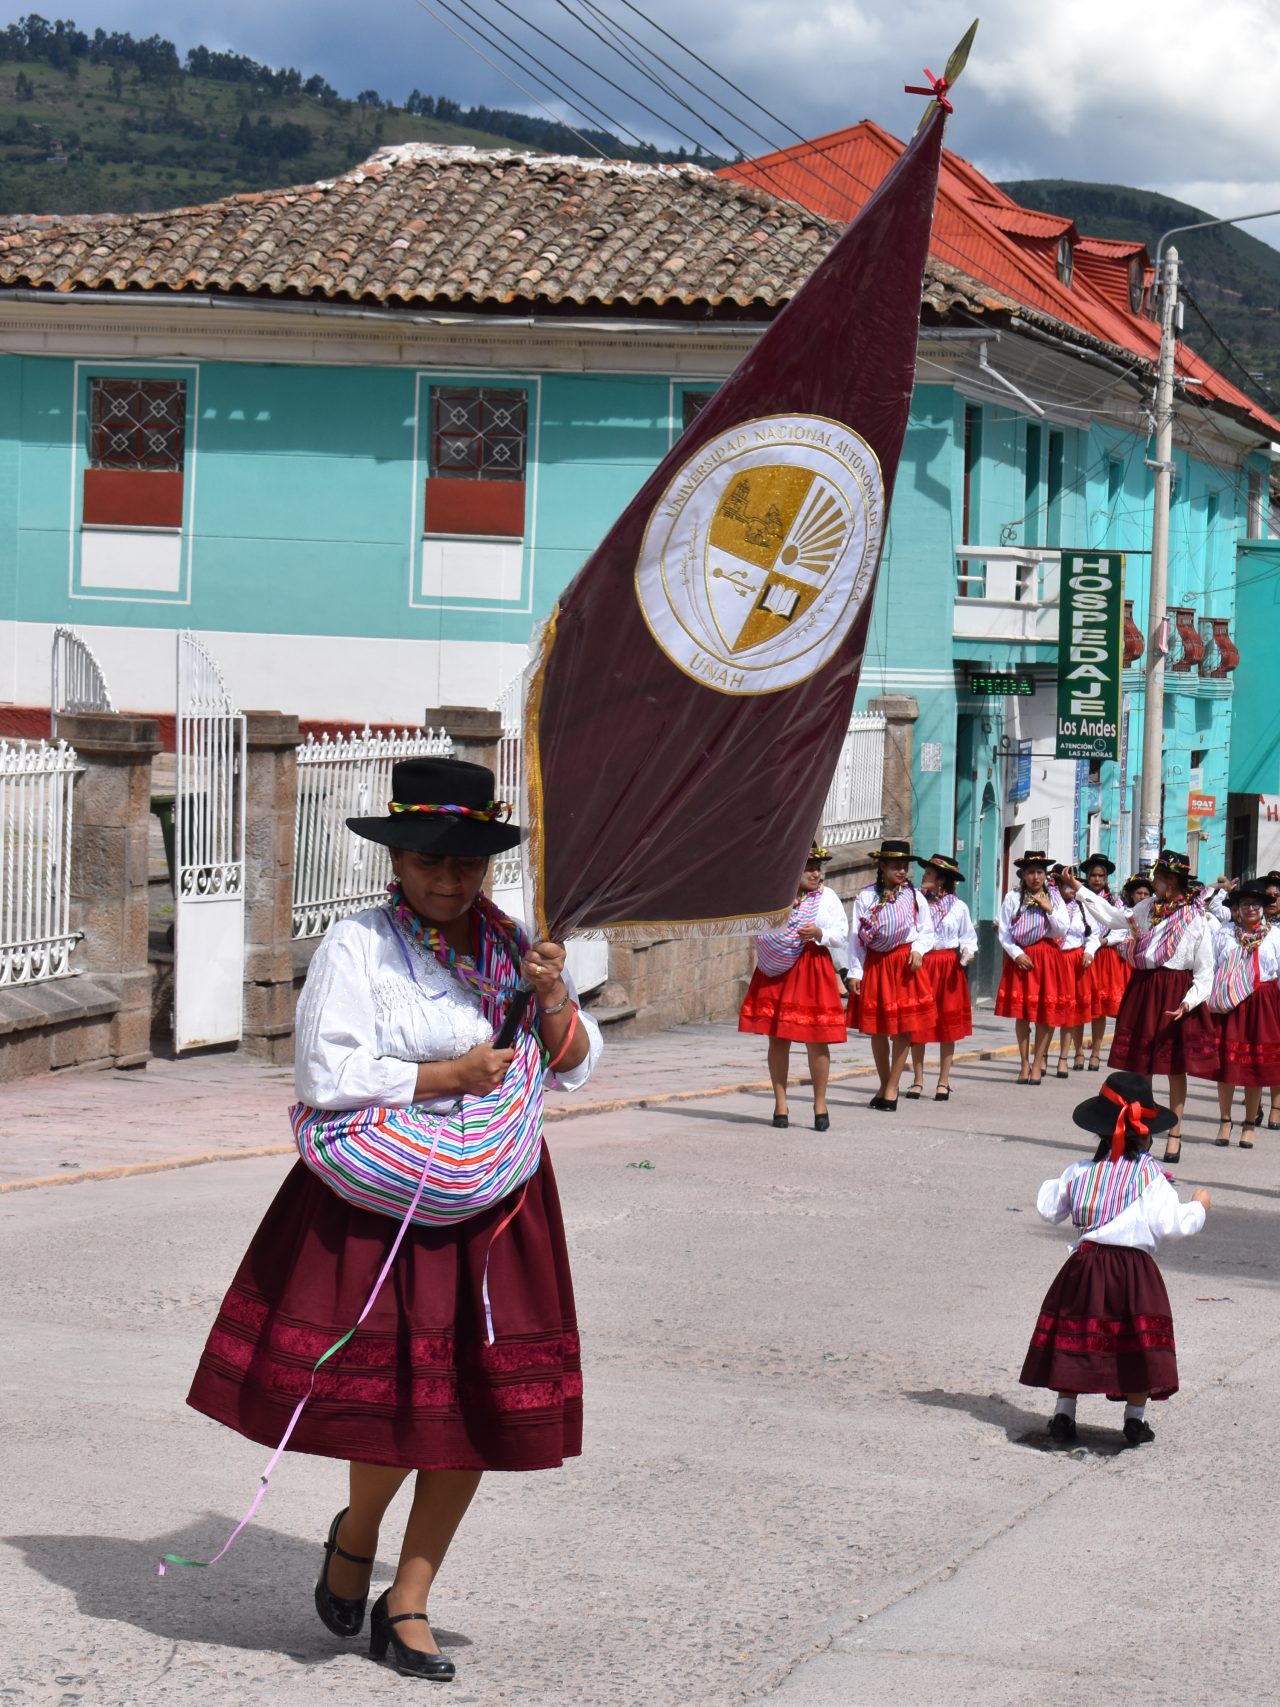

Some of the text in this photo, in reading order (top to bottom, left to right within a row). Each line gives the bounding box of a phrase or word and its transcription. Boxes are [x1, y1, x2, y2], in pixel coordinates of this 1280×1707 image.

[754, 425, 832, 447] NACIONAL
[665, 434, 748, 519] UNIVERSIDAD
[868, 510, 878, 530] DE
[850, 537, 876, 601] HUANTA
[1065, 557, 1113, 717] HOSPEDAJE
[689, 653, 745, 688] UNAH
[1059, 717, 1117, 738] Los Andes
[1060, 742, 1093, 750] ATENCIÓN
[1191, 799, 1214, 808] SOAT
